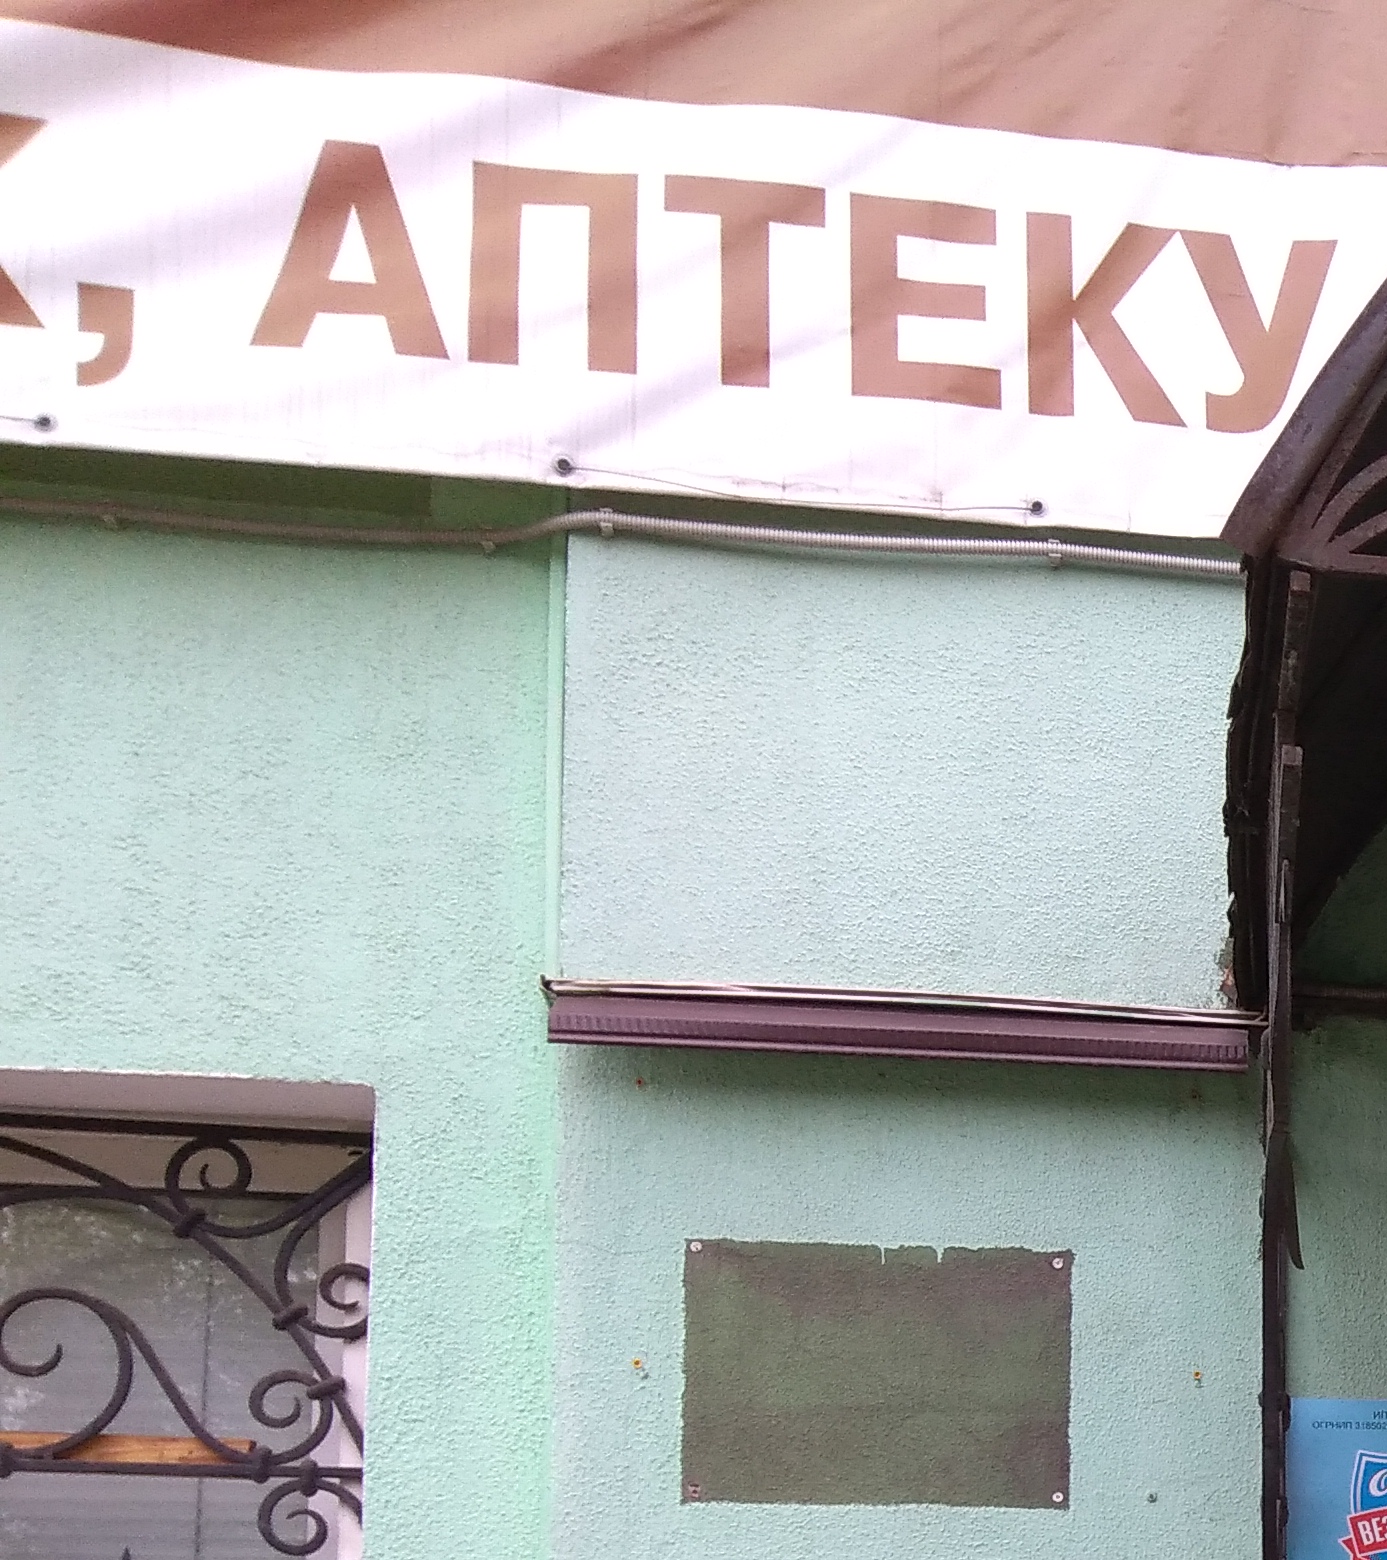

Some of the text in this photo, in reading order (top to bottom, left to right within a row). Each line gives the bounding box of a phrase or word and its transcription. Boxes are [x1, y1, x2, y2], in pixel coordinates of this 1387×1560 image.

[250, 138, 1338, 434] АПТЕКУ
[1373, 1410, 1387, 1420] ИП
[1312, 1421, 1353, 1430] ОГРНИП
